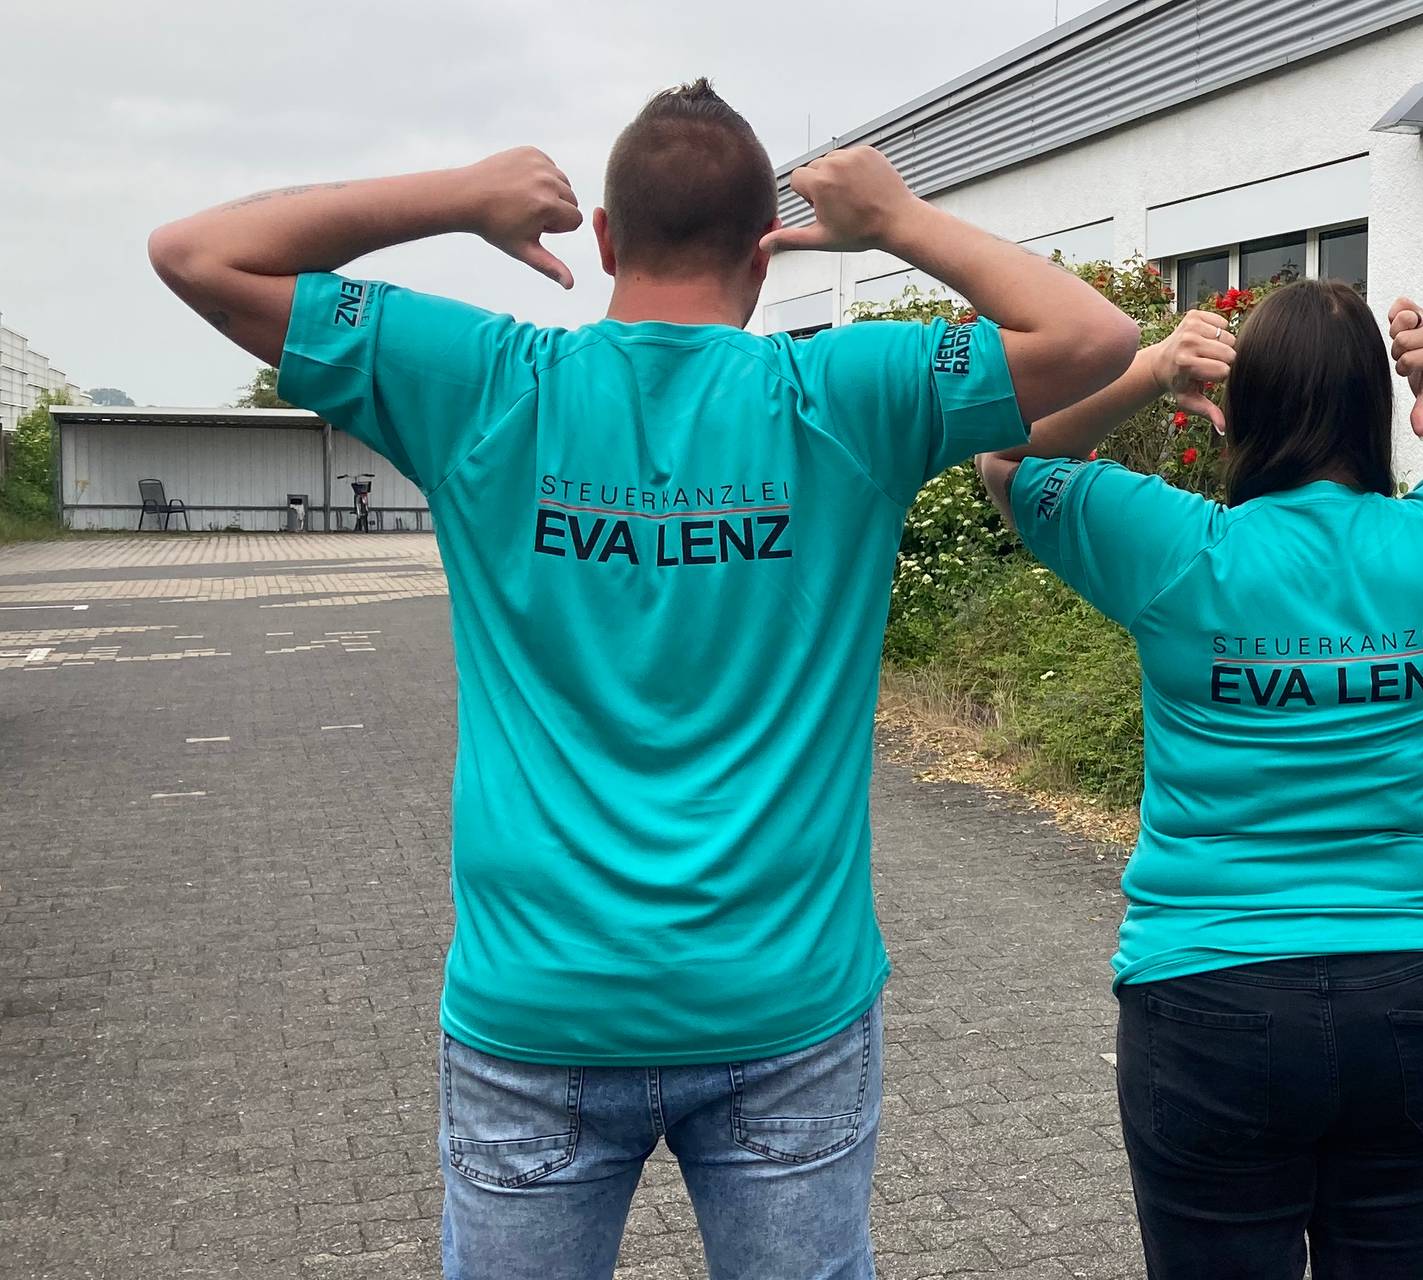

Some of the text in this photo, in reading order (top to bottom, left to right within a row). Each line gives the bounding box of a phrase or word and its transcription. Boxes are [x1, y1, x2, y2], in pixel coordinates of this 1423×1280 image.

[334, 281, 363, 328] ENZ
[540, 475, 790, 510] STEUERKANZLEI
[1036, 467, 1071, 520] LENZ
[533, 508, 793, 567] EVA LENZ
[1211, 664, 1317, 708] EVA
